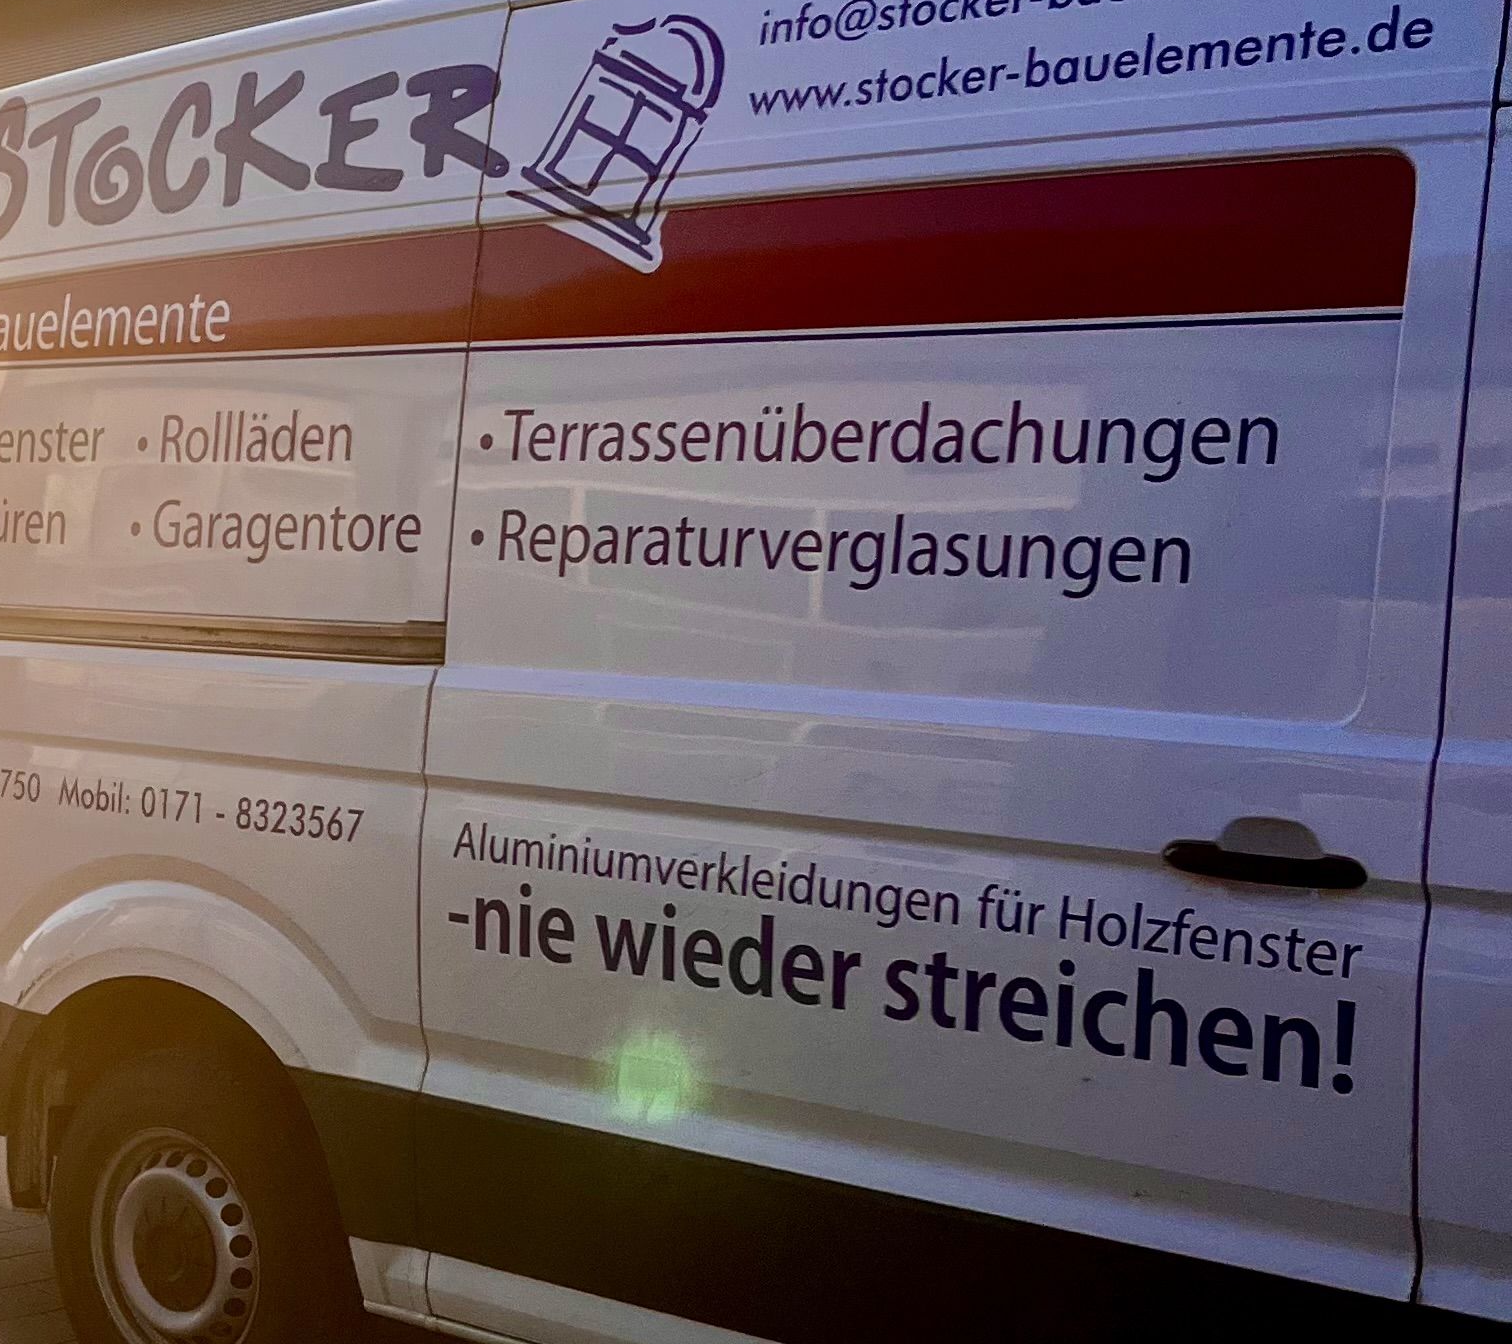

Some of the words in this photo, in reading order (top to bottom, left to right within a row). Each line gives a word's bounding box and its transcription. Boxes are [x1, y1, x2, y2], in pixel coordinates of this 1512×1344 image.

[750, 5, 1434, 117] www.stocker-bauelemente.de
[160, 409, 352, 463] Rollläden
[503, 401, 1279, 483] Terrassenüberdachungen
[153, 499, 421, 563] Garagentore
[497, 509, 1192, 599] Reparaturverglasungen
[58, 775, 130, 816] Mobil:
[140, 786, 202, 824] 0171
[235, 796, 365, 842] 8323567
[453, 821, 960, 928] Aluminiumverkleidungen
[978, 884, 1045, 936] für
[1059, 895, 1363, 979] Holzfenster
[448, 882, 575, 964] -nie
[594, 902, 861, 1010] wieder
[883, 952, 1356, 1094] streichen!
